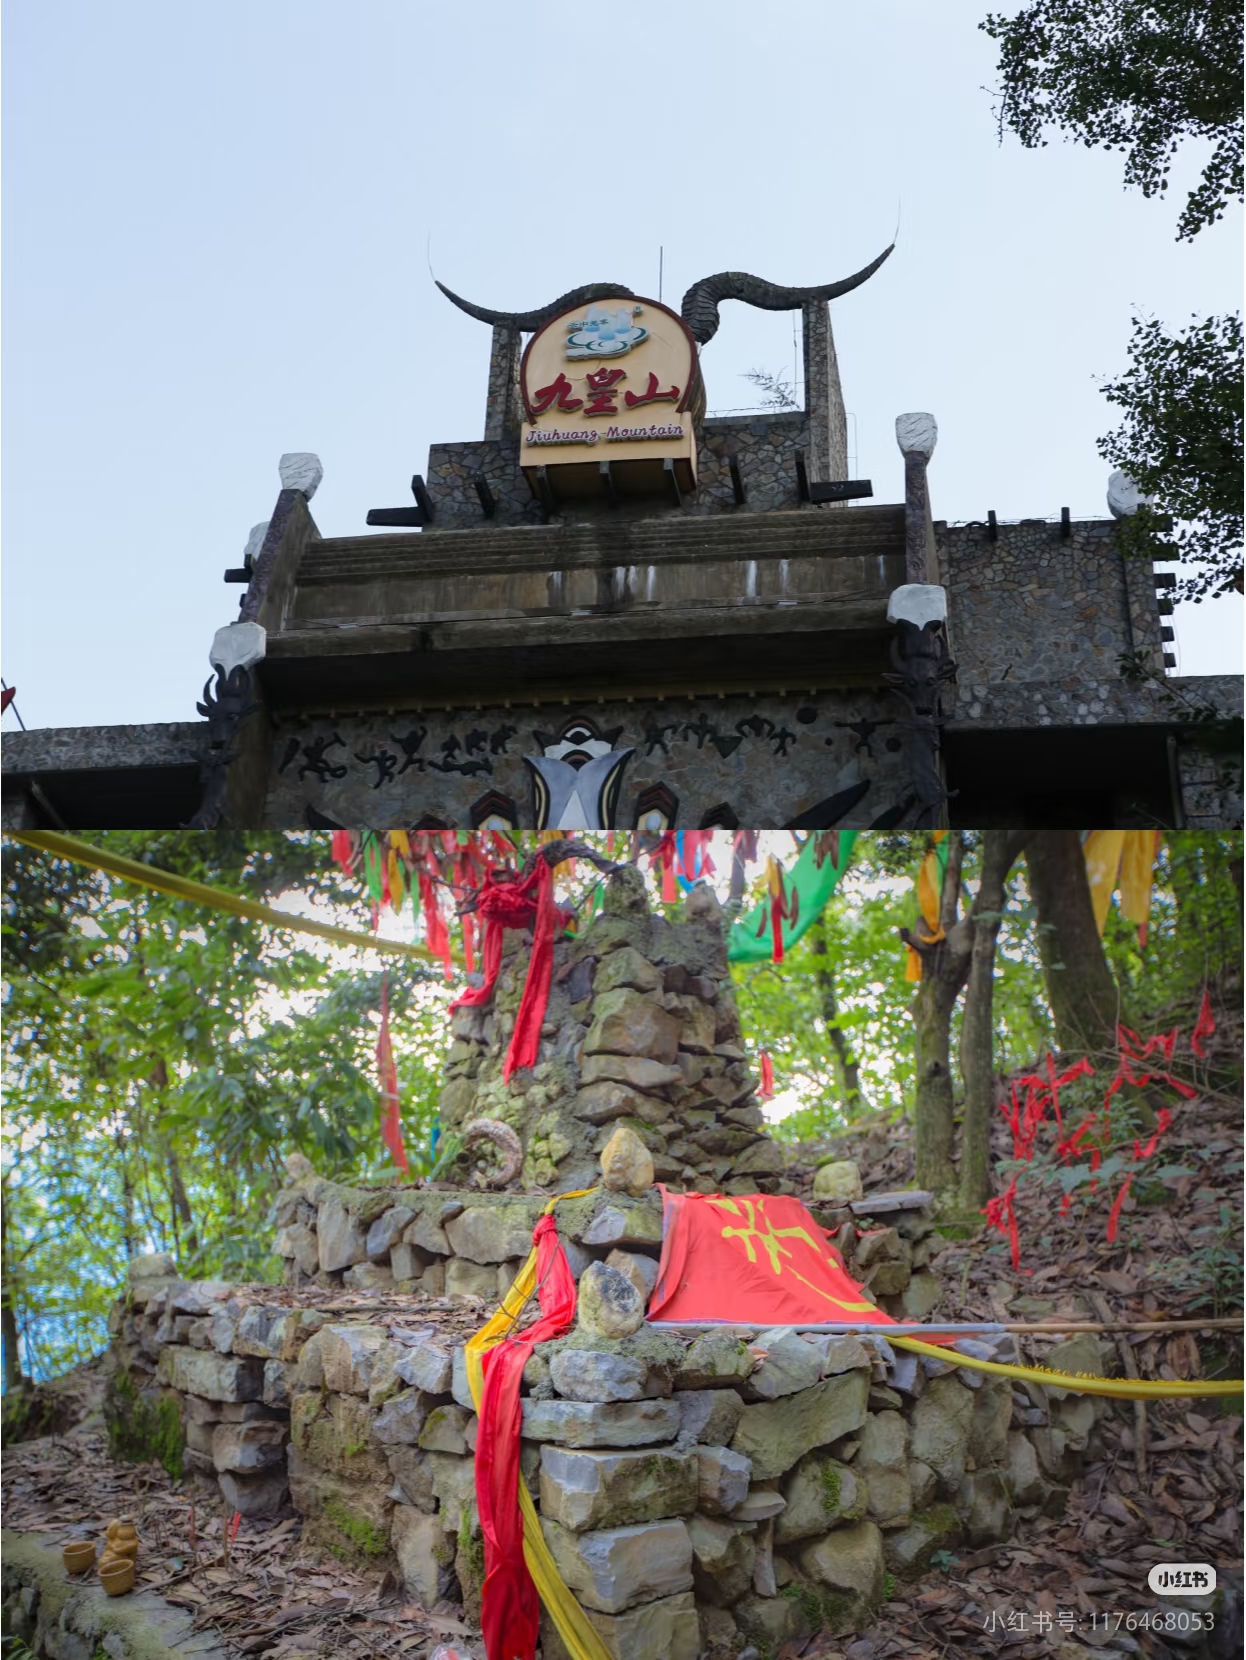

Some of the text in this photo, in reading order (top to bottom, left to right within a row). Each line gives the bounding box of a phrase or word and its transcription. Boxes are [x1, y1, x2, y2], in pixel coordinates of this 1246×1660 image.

[531, 367, 681, 416] 九皇山
[526, 424, 684, 442] Jiuhuang Mountain
